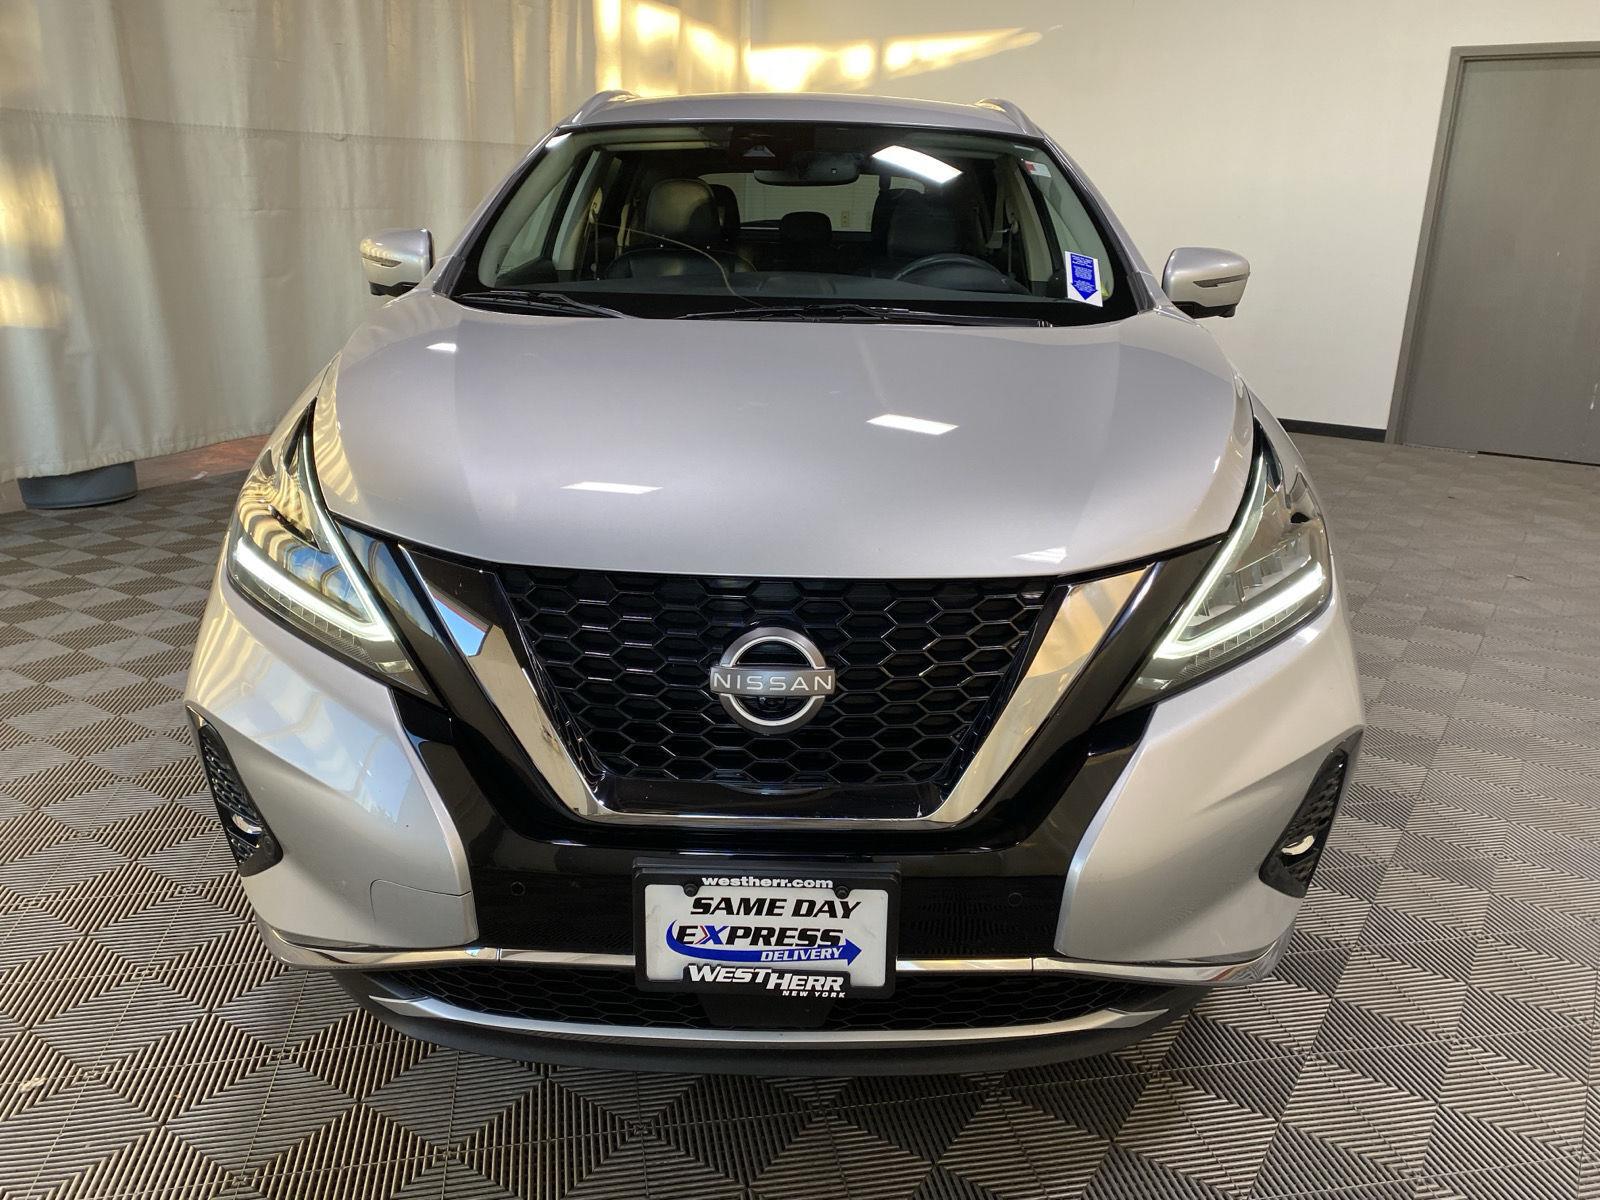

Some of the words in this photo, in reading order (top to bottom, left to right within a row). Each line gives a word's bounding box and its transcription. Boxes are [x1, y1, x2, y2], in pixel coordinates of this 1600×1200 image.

[713, 672, 831, 691] NISSAN
[702, 876, 833, 888] westherr.com
[690, 896, 786, 917] SAME
[791, 898, 861, 919] DAY
[675, 925, 844, 947] EXPRESS
[760, 946, 843, 962] DELIVERY
